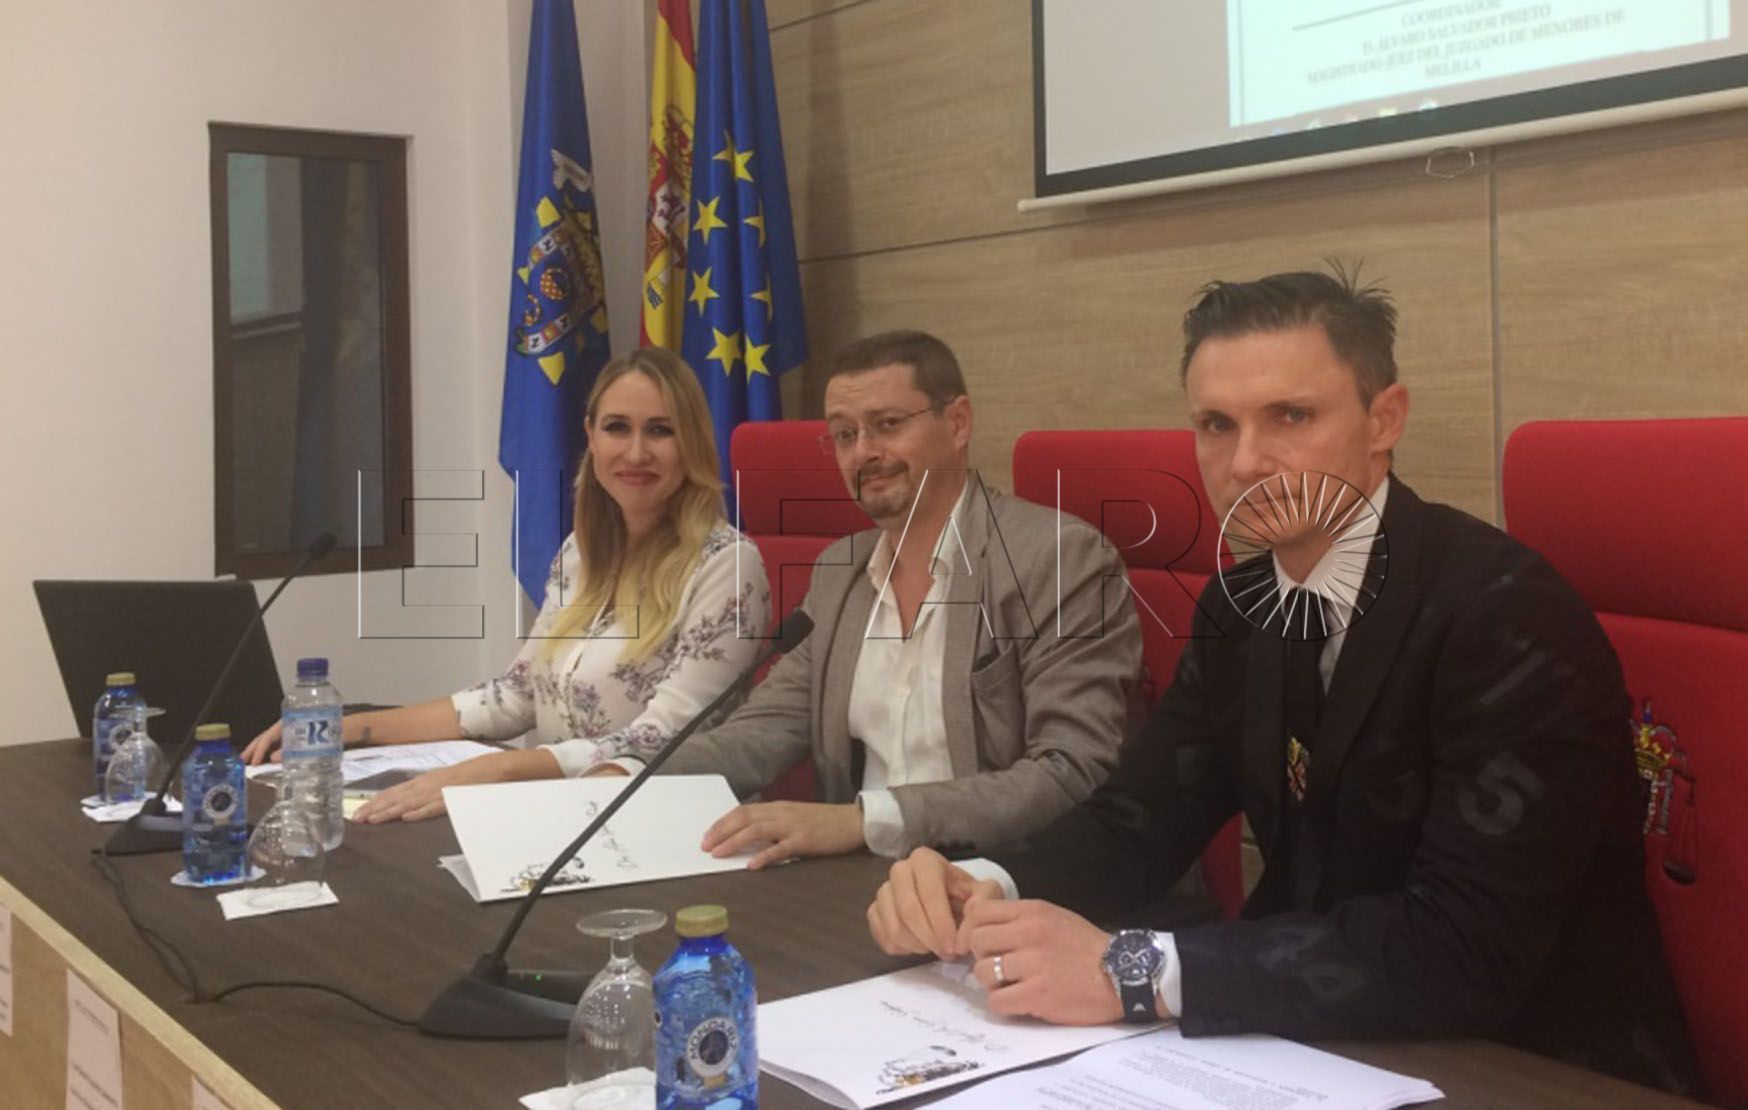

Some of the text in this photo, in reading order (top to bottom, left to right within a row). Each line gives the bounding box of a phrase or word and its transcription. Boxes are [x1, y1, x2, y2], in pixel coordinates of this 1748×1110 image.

[1416, 44, 1440, 62] DEL
[1443, 33, 1506, 58] JUZGADO
[1508, 27, 1527, 45] DE
[1529, 13, 1601, 40] MENORES
[1604, 8, 1626, 26] DE
[1427, 16, 1497, 41] SALVADOR
[1500, 4, 1552, 27] PRIETO
[1424, 57, 1482, 79] MELILLA
